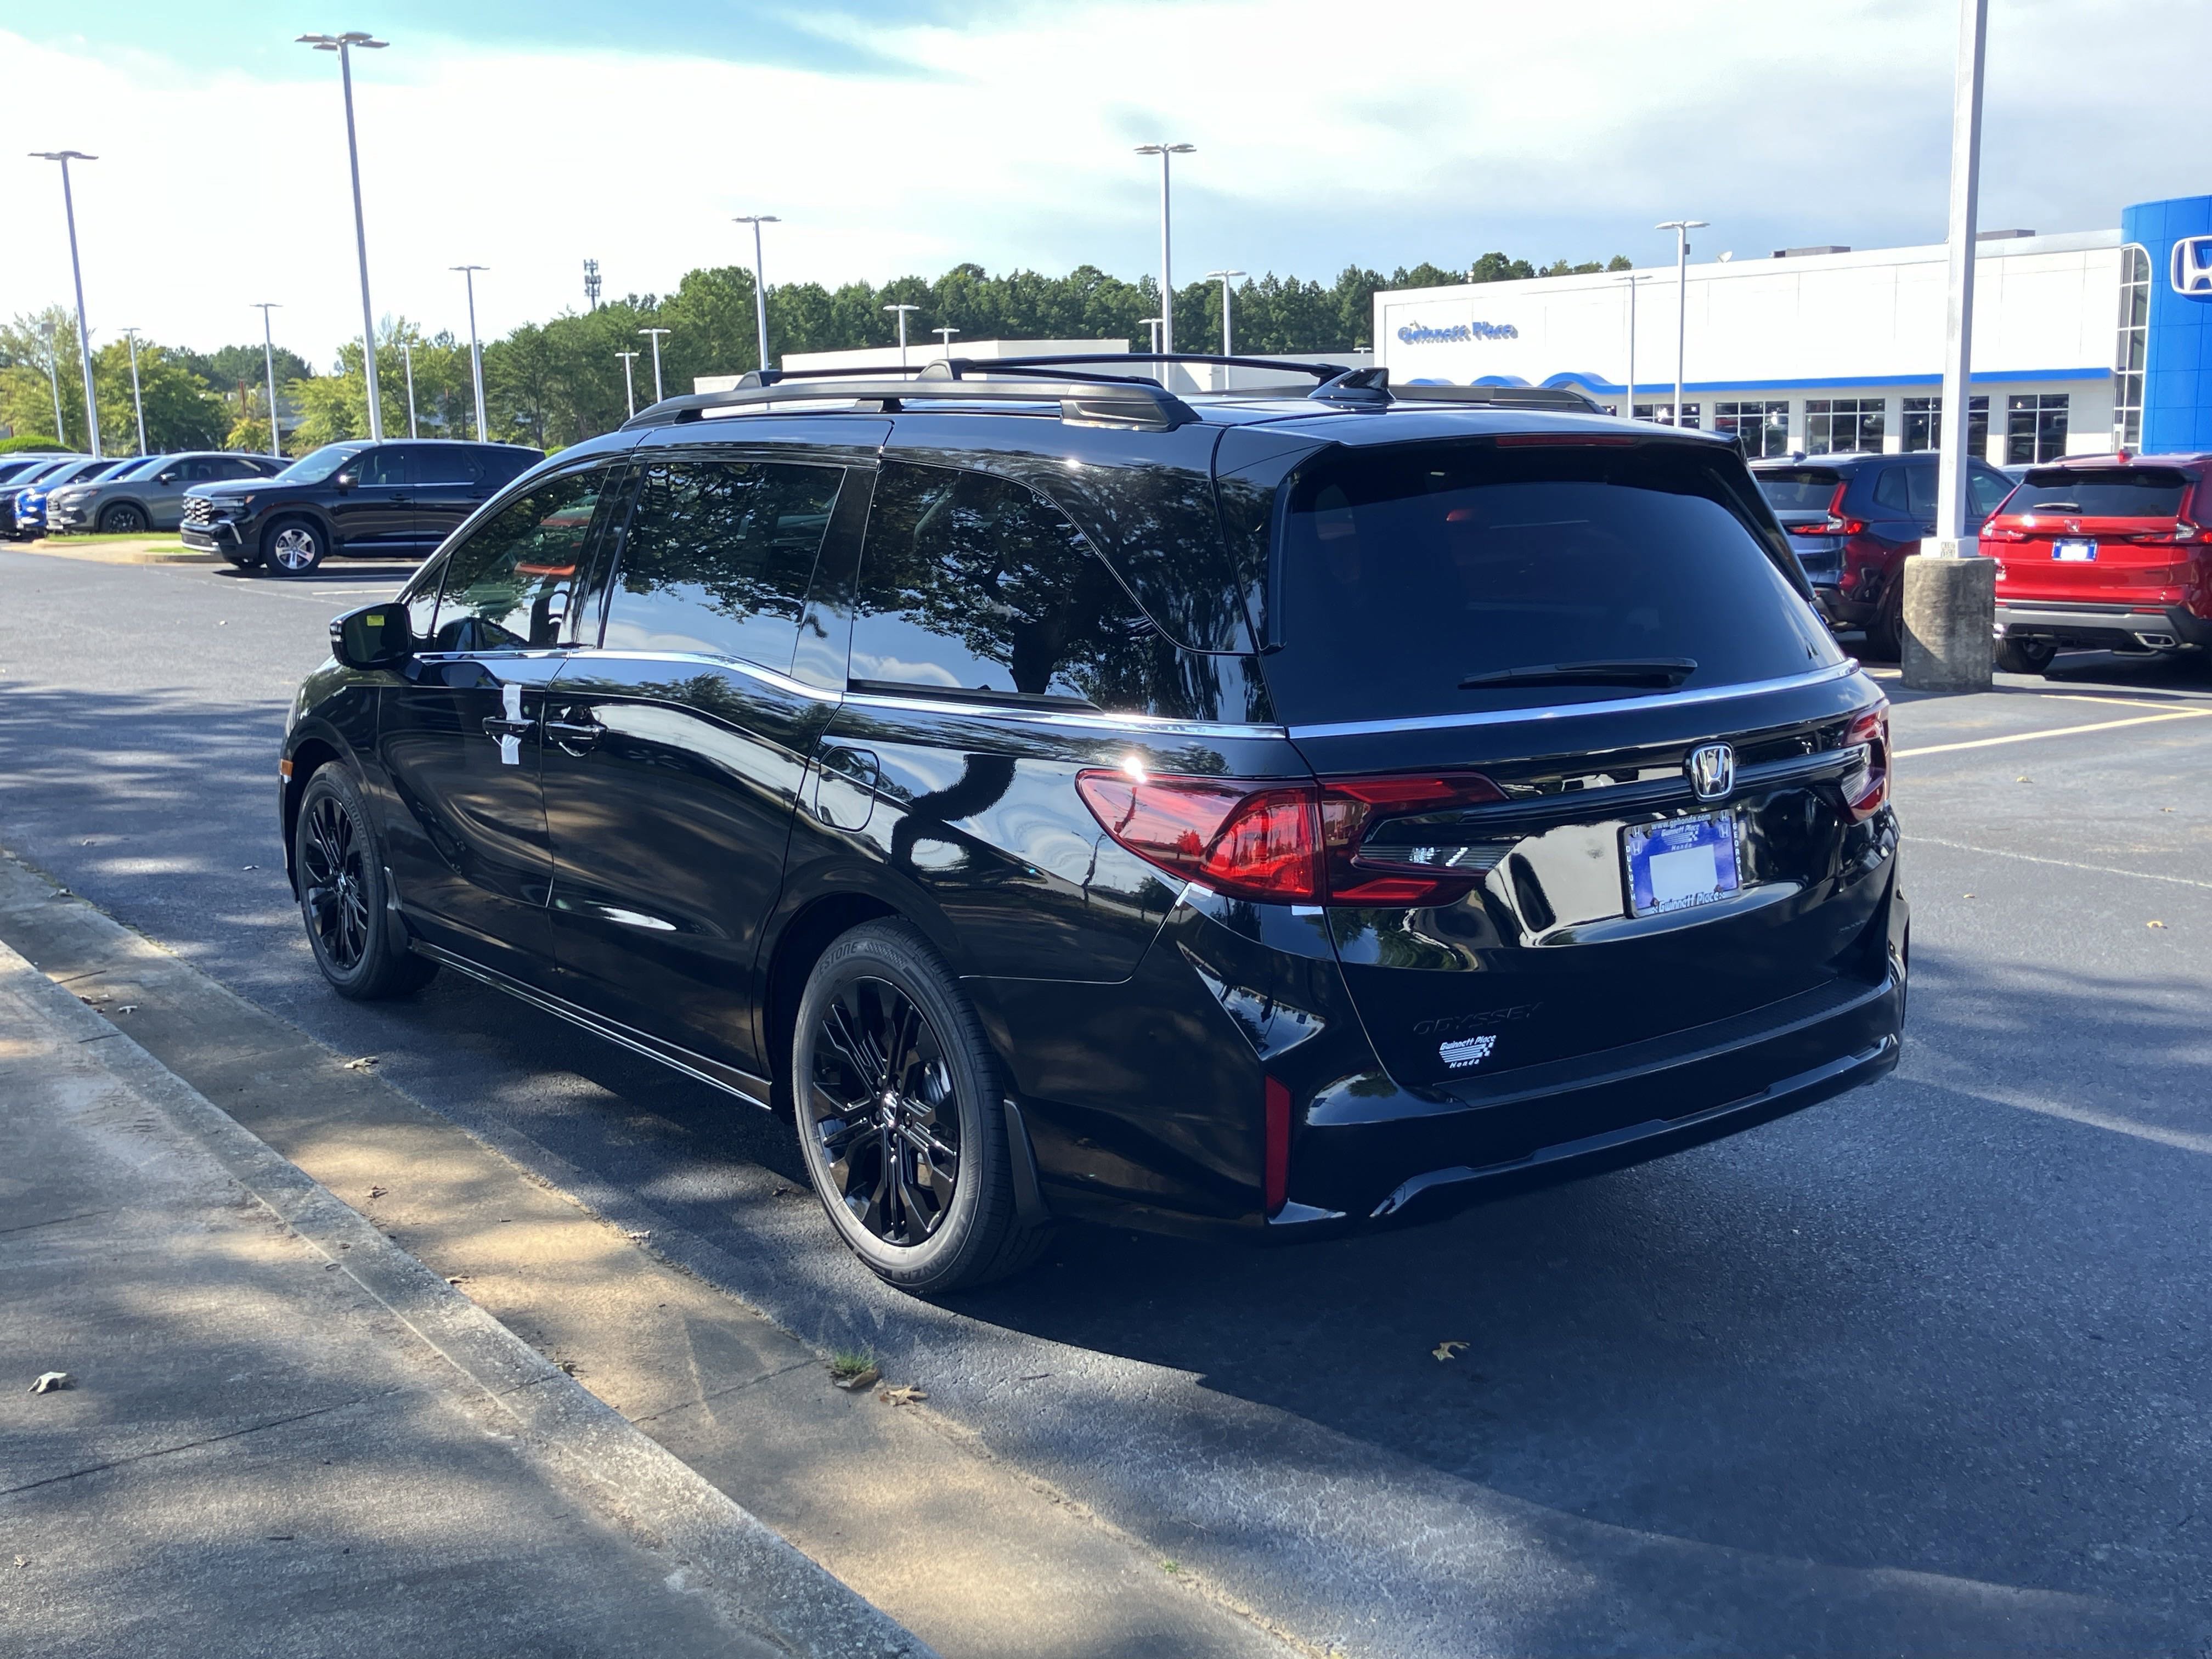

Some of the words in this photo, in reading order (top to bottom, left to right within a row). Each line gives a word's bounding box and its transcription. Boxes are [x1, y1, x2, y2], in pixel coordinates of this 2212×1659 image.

[1472, 321, 1516, 337] Place
[1651, 814, 1711, 830] www.gphonda.com
[1661, 826, 1685, 837] Gwinnett
[1685, 824, 1700, 833] Place
[1671, 843, 1692, 851] Honda
[1733, 822, 1743, 881] GEORGIA
[1626, 845, 1636, 901] DULUTH
[1659, 895, 1695, 912] Gwinnett
[1697, 891, 1720, 905] Place
[1413, 1001, 1544, 1035] ODYSSEY
[1440, 1038, 1474, 1051] Gwinnett
[1475, 1035, 1496, 1045] Place
[1449, 1059, 1480, 1069] Honda
